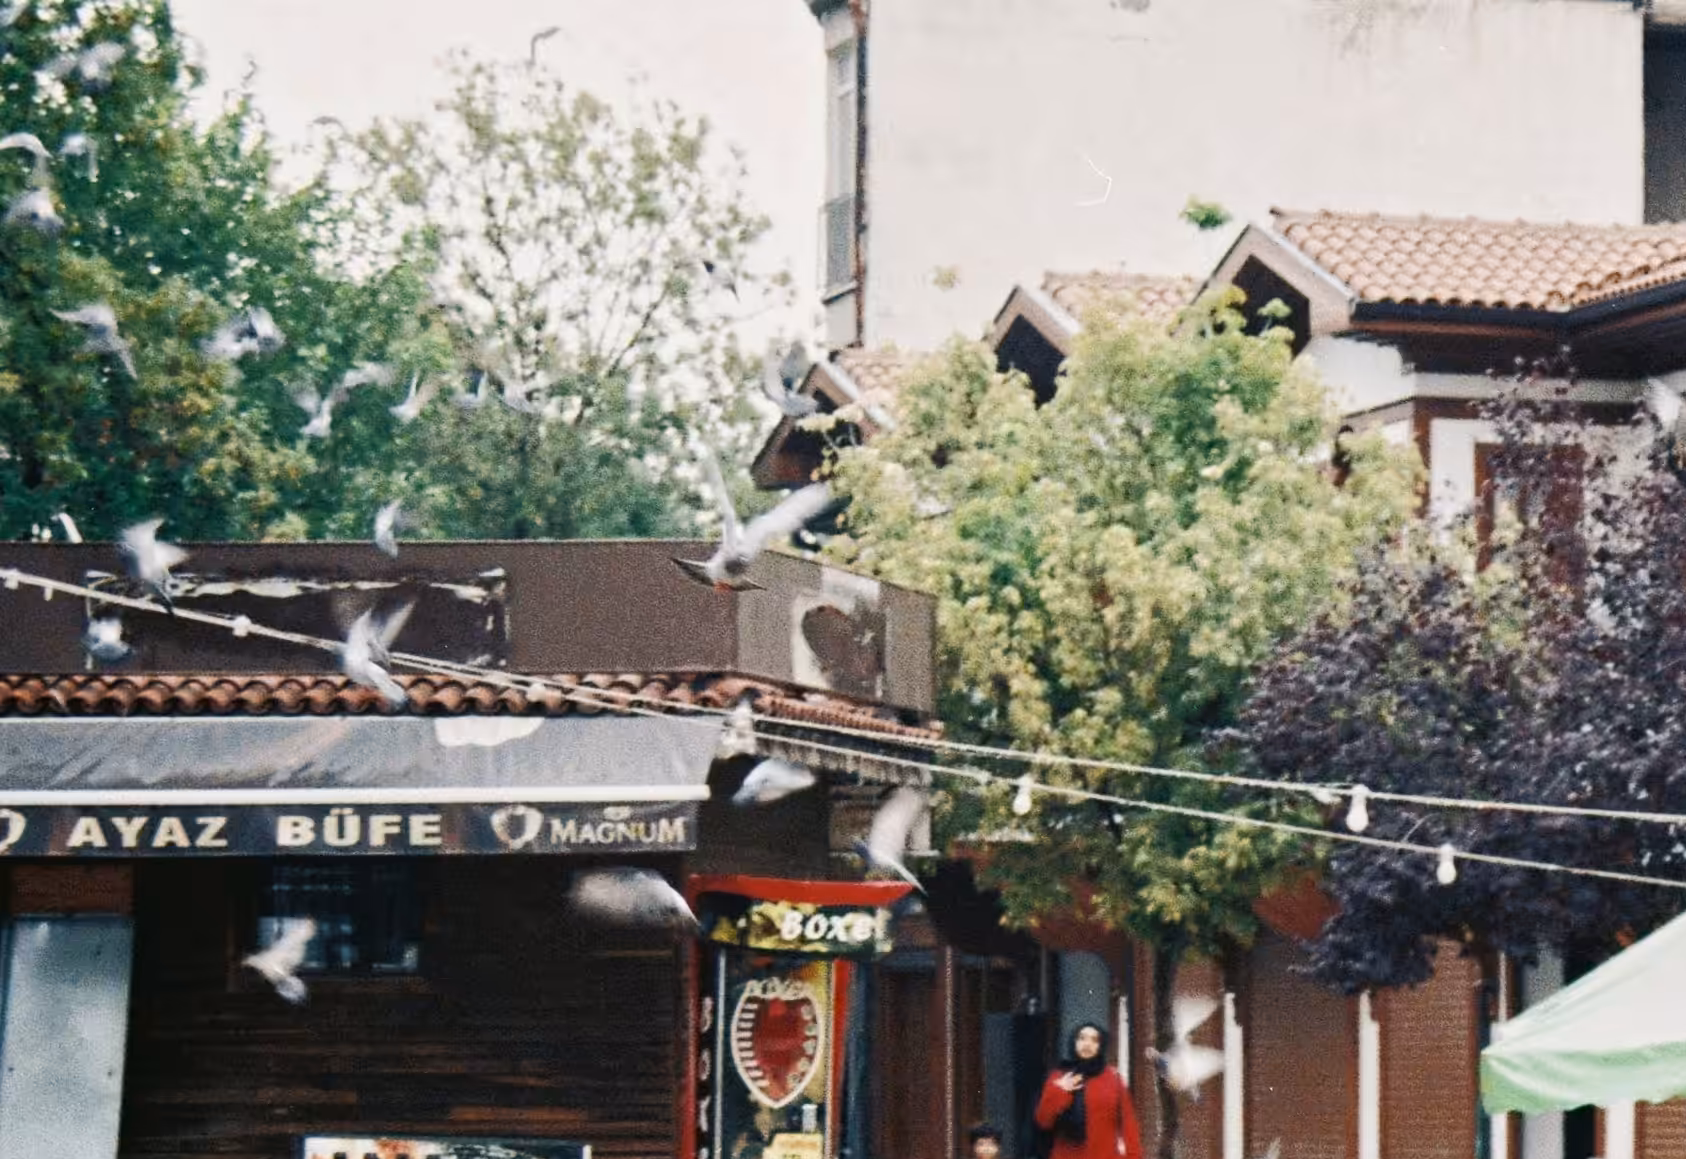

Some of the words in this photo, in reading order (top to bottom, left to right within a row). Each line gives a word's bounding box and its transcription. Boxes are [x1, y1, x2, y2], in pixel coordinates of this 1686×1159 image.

[66, 816, 229, 848] AYAZ
[276, 807, 443, 848] BÜFE
[550, 816, 687, 844] MAGNUM
